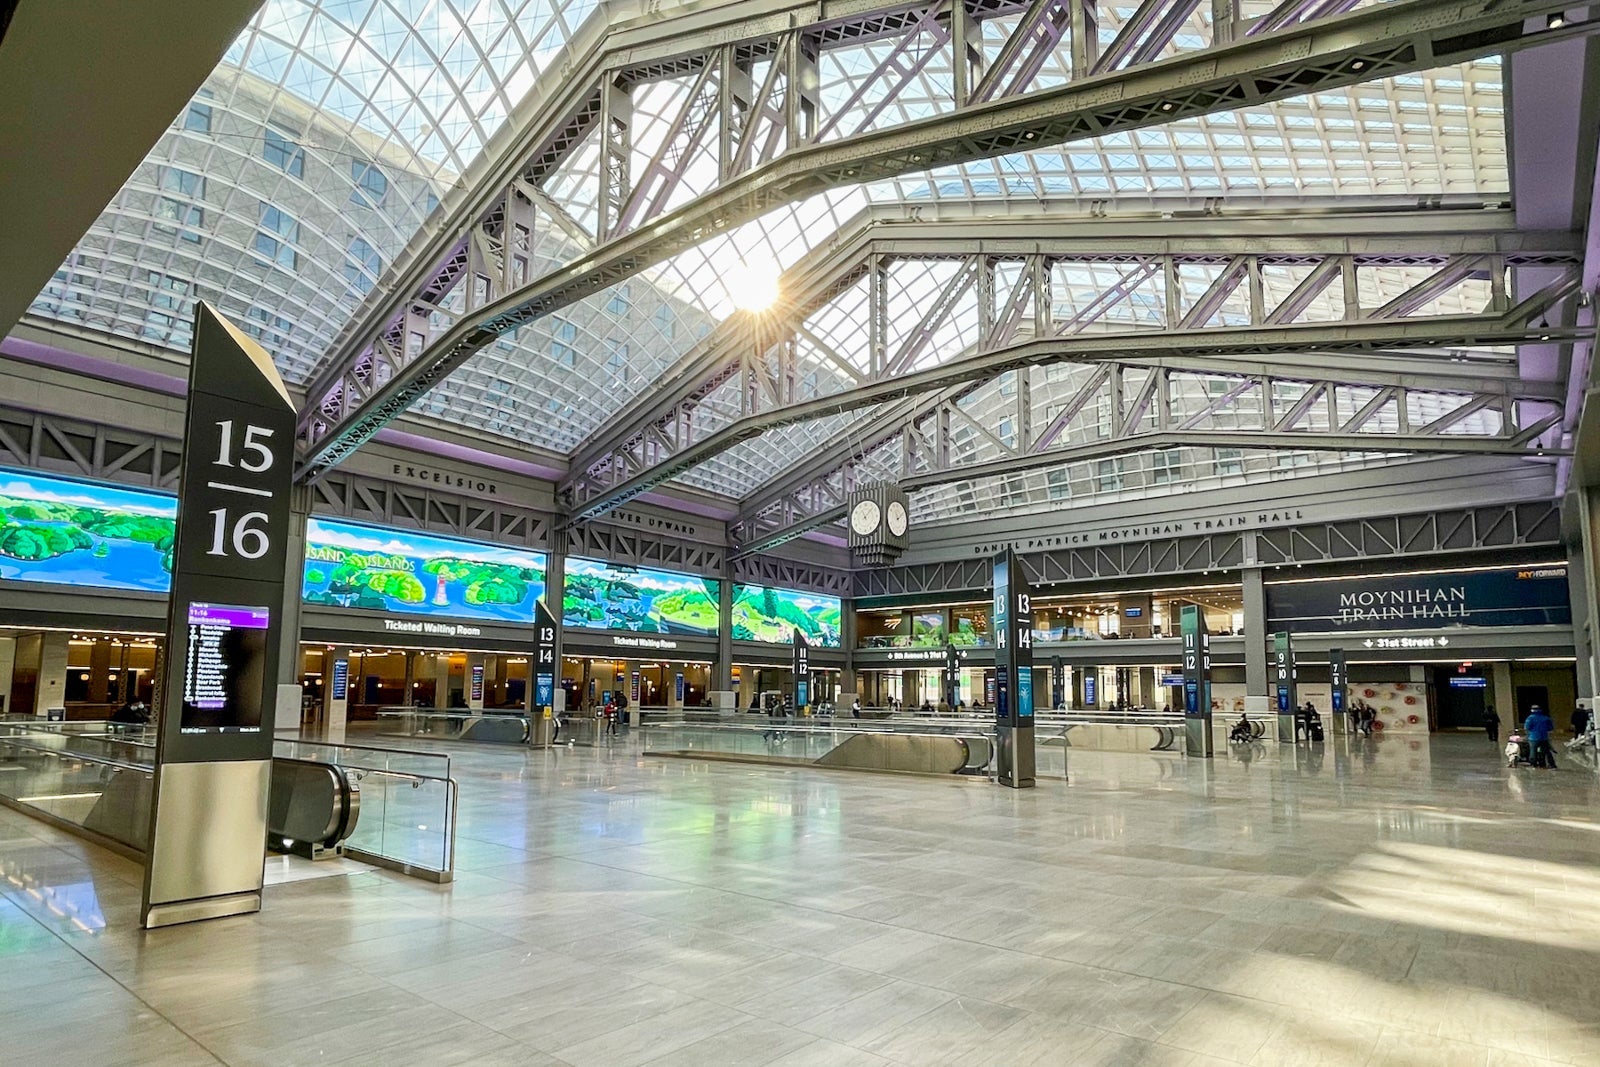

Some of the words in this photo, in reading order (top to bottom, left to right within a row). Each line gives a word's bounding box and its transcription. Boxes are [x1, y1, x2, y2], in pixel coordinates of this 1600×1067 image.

[211, 420, 275, 473] 15
[393, 464, 497, 494] EXCELSIOR
[611, 510, 641, 524] EVER
[648, 518, 695, 535] UPWARD
[206, 507, 270, 560] 16
[975, 541, 1020, 554] DANIEL
[1028, 534, 1089, 548] PATRICK
[1099, 523, 1183, 541] MOYNIHAN
[1193, 516, 1247, 531] TRAIN
[1258, 510, 1304, 524] HALL
[366, 556, 416, 572] ISLANDS
[997, 594, 1005, 615] 13
[1018, 594, 1030, 614] 13
[1340, 586, 1465, 607] MOYNIHAN
[1338, 605, 1404, 622] TRAIN
[1412, 603, 1471, 619] HALL
[384, 619, 423, 632] Ticketed
[423, 622, 457, 636] Waiting
[456, 624, 481, 636] Room
[541, 627, 554, 641] 13
[997, 628, 1006, 649] 14
[1018, 628, 1031, 649] 14
[1186, 634, 1194, 647] 11
[1377, 638, 1400, 648] 31st
[1401, 637, 1435, 648] Street
[539, 649, 553, 664] 14
[800, 647, 807, 659] 11
[1279, 652, 1285, 663] 9
[799, 663, 808, 675] 12
[1186, 656, 1196, 670] 12
[1333, 664, 1339, 673] 7
[1278, 668, 1287, 680] 10
[1333, 676, 1339, 686] 8
